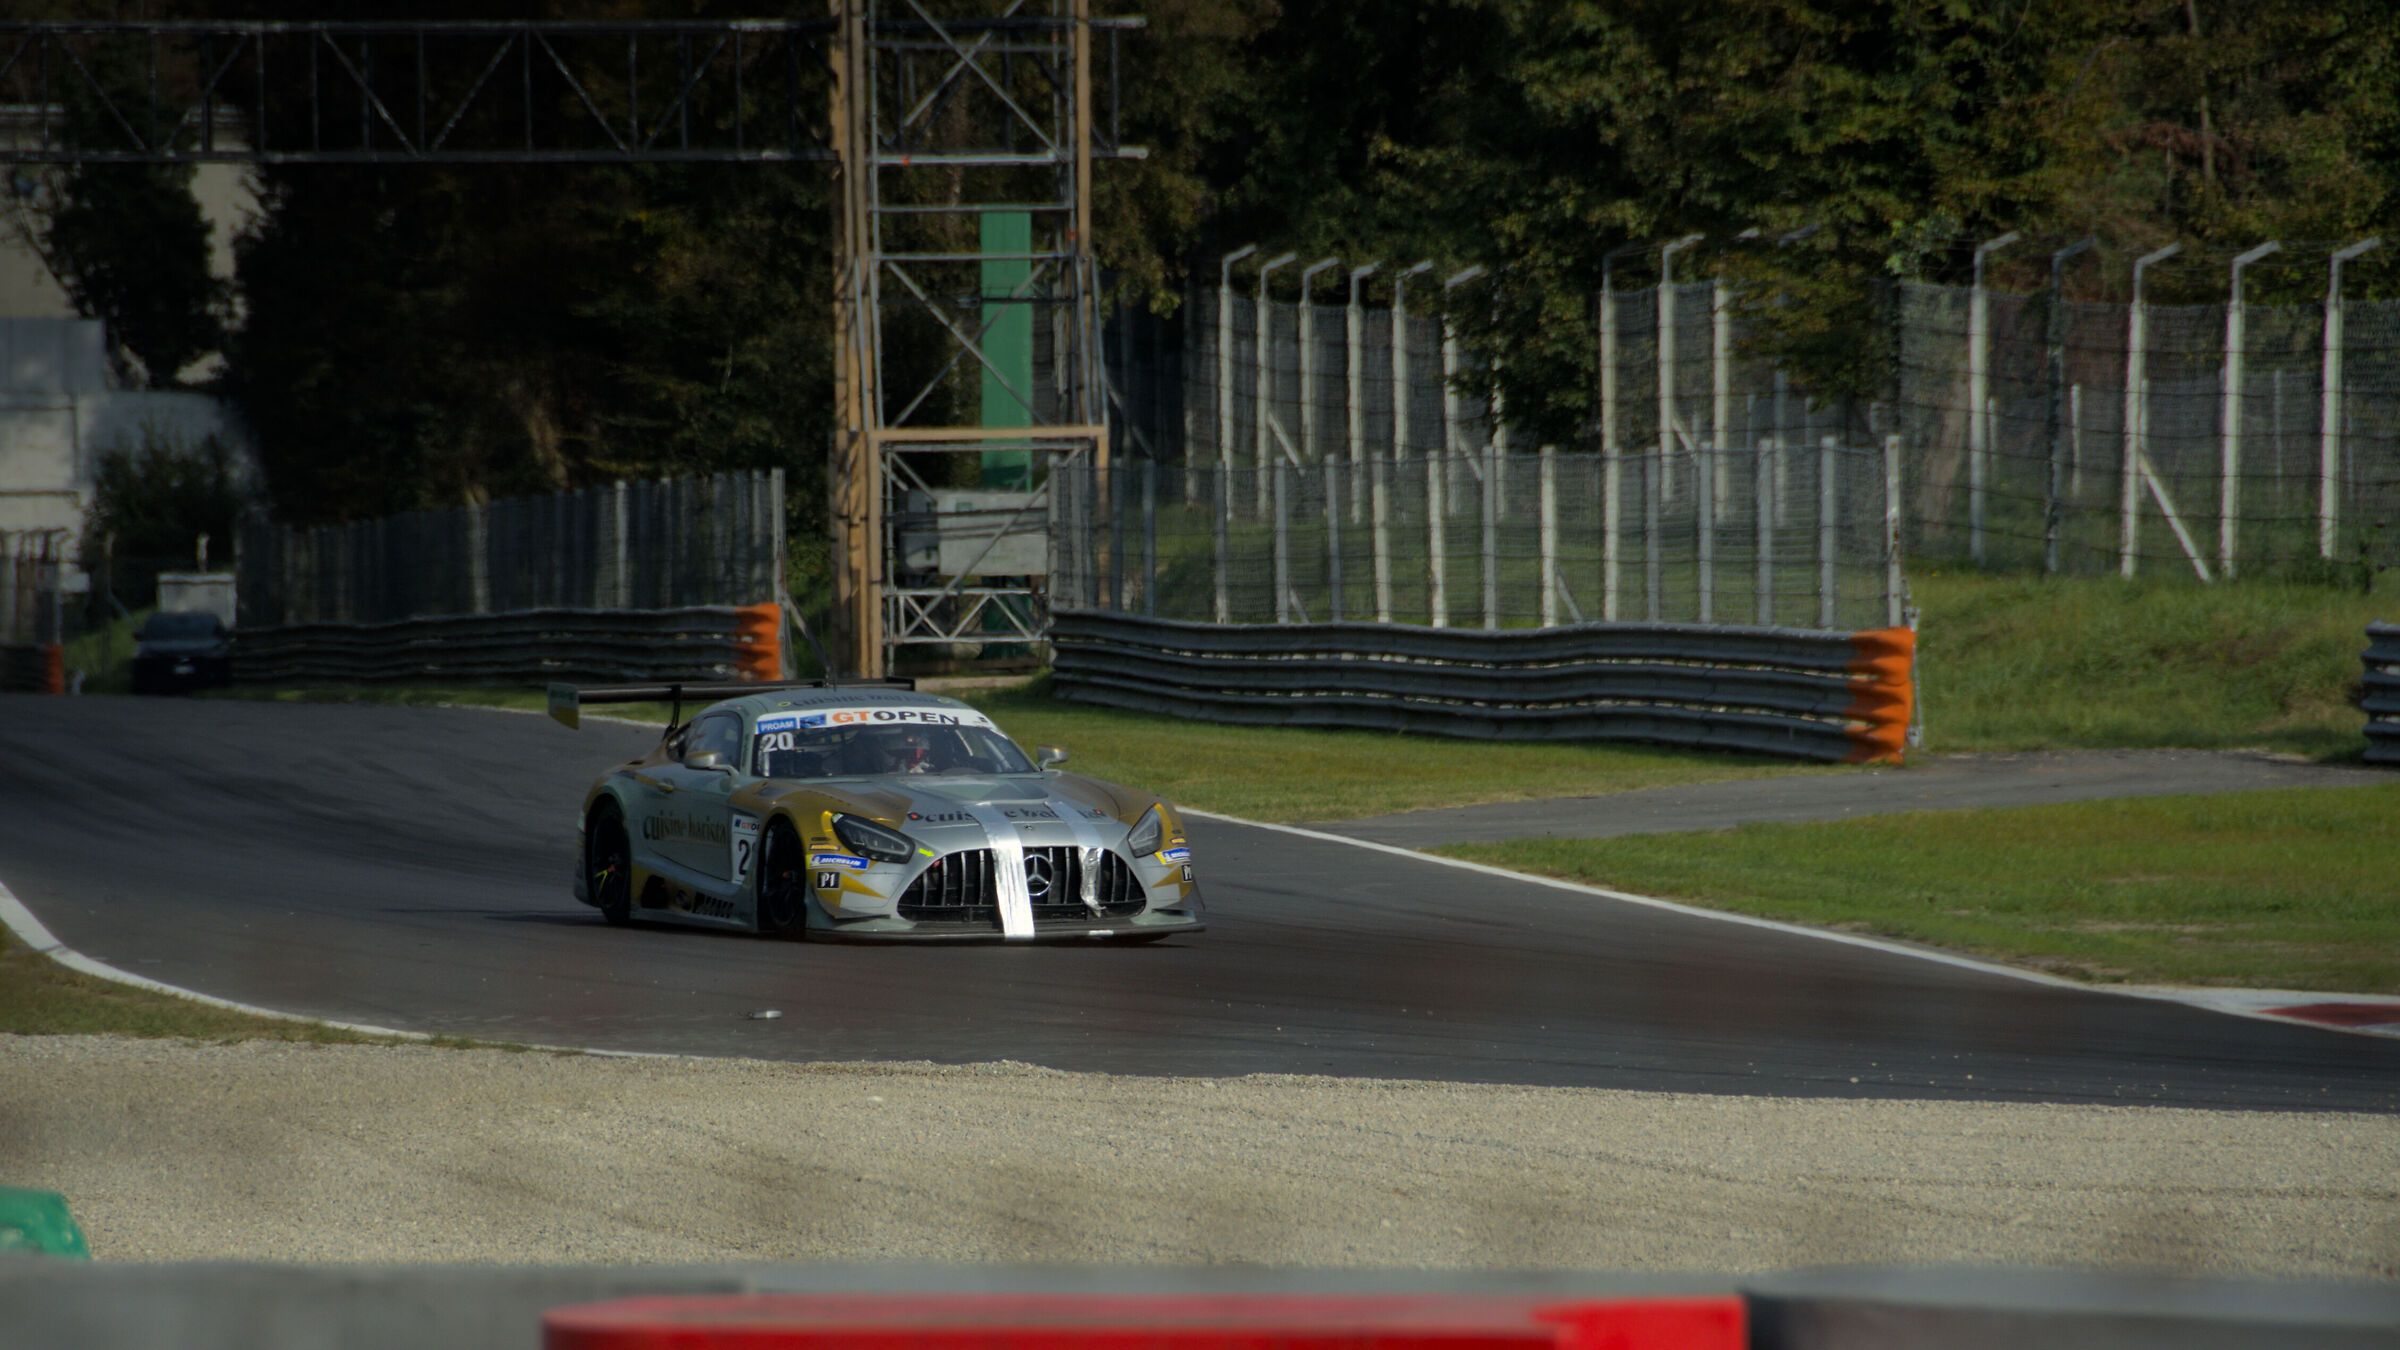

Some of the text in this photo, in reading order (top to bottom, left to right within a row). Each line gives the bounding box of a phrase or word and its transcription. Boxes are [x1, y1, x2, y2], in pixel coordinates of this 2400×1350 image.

[761, 731, 794, 753] 20
[819, 857, 862, 867] MICHELIN
[820, 872, 836, 888] P1
